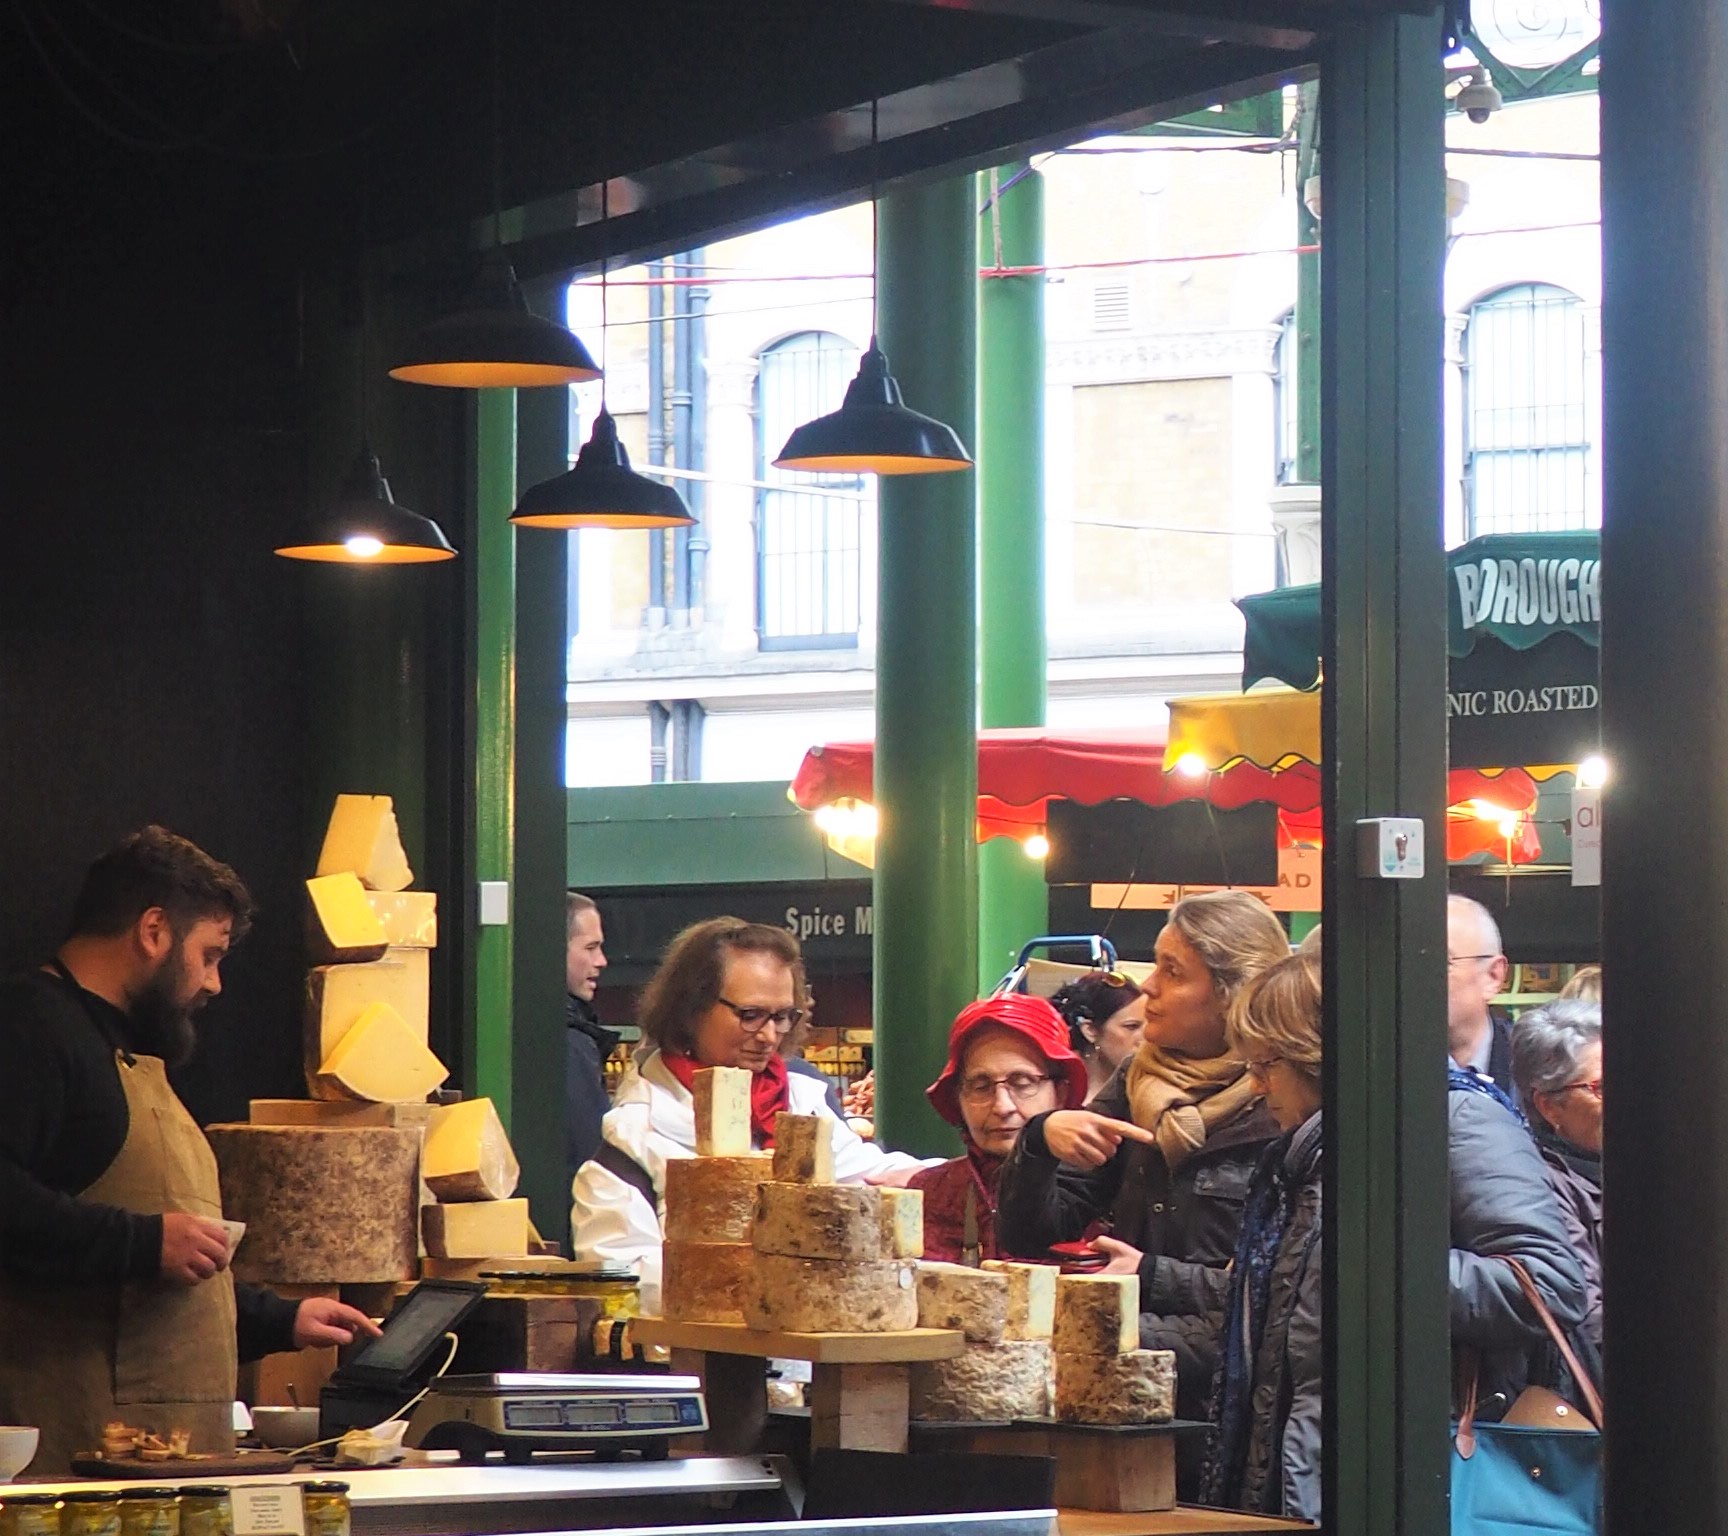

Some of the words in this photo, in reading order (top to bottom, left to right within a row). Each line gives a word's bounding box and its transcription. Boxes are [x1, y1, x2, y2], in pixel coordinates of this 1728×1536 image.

[1453, 558, 1601, 630] BOROUGH
[1492, 684, 1600, 715] ROASTED
[785, 906, 846, 941] Spice
